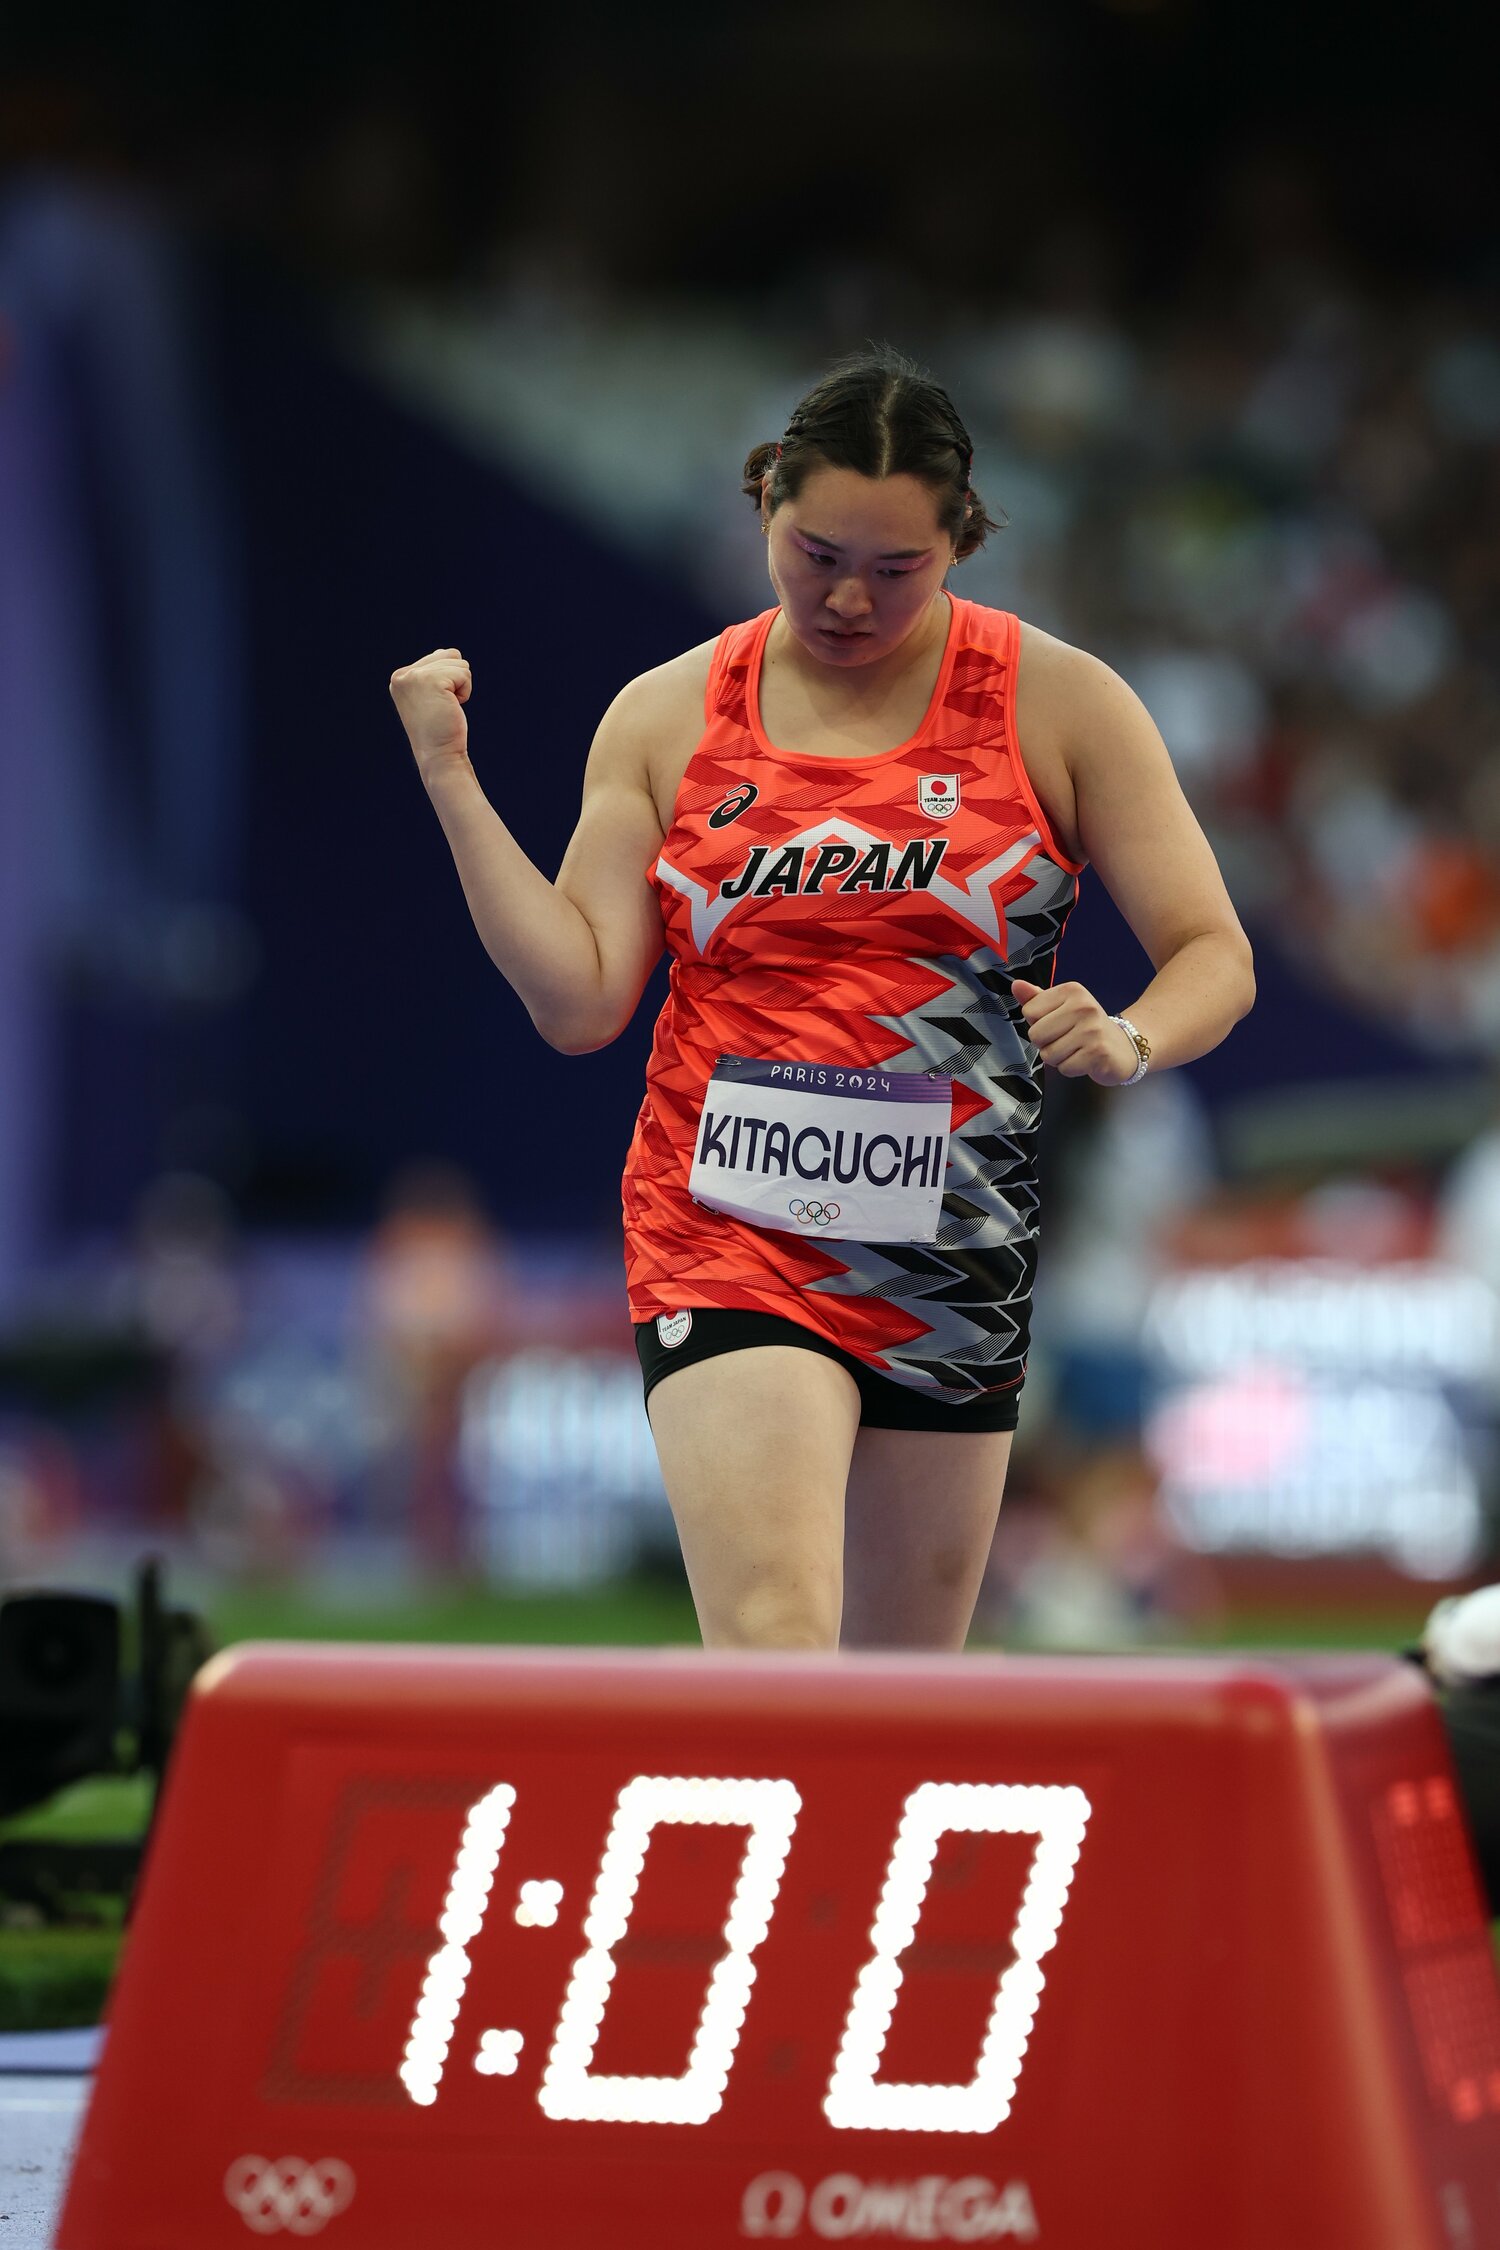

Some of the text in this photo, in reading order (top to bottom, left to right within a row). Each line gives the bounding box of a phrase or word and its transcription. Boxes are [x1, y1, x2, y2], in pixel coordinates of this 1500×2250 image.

[721, 839, 950, 898] JAPAN
[835, 1073, 890, 1092] 2024
[699, 1112, 943, 1188] KITAGUCHI
[673, 1317, 687, 1327] JAPAN
[807, 2171, 1039, 2243] OMEGA
